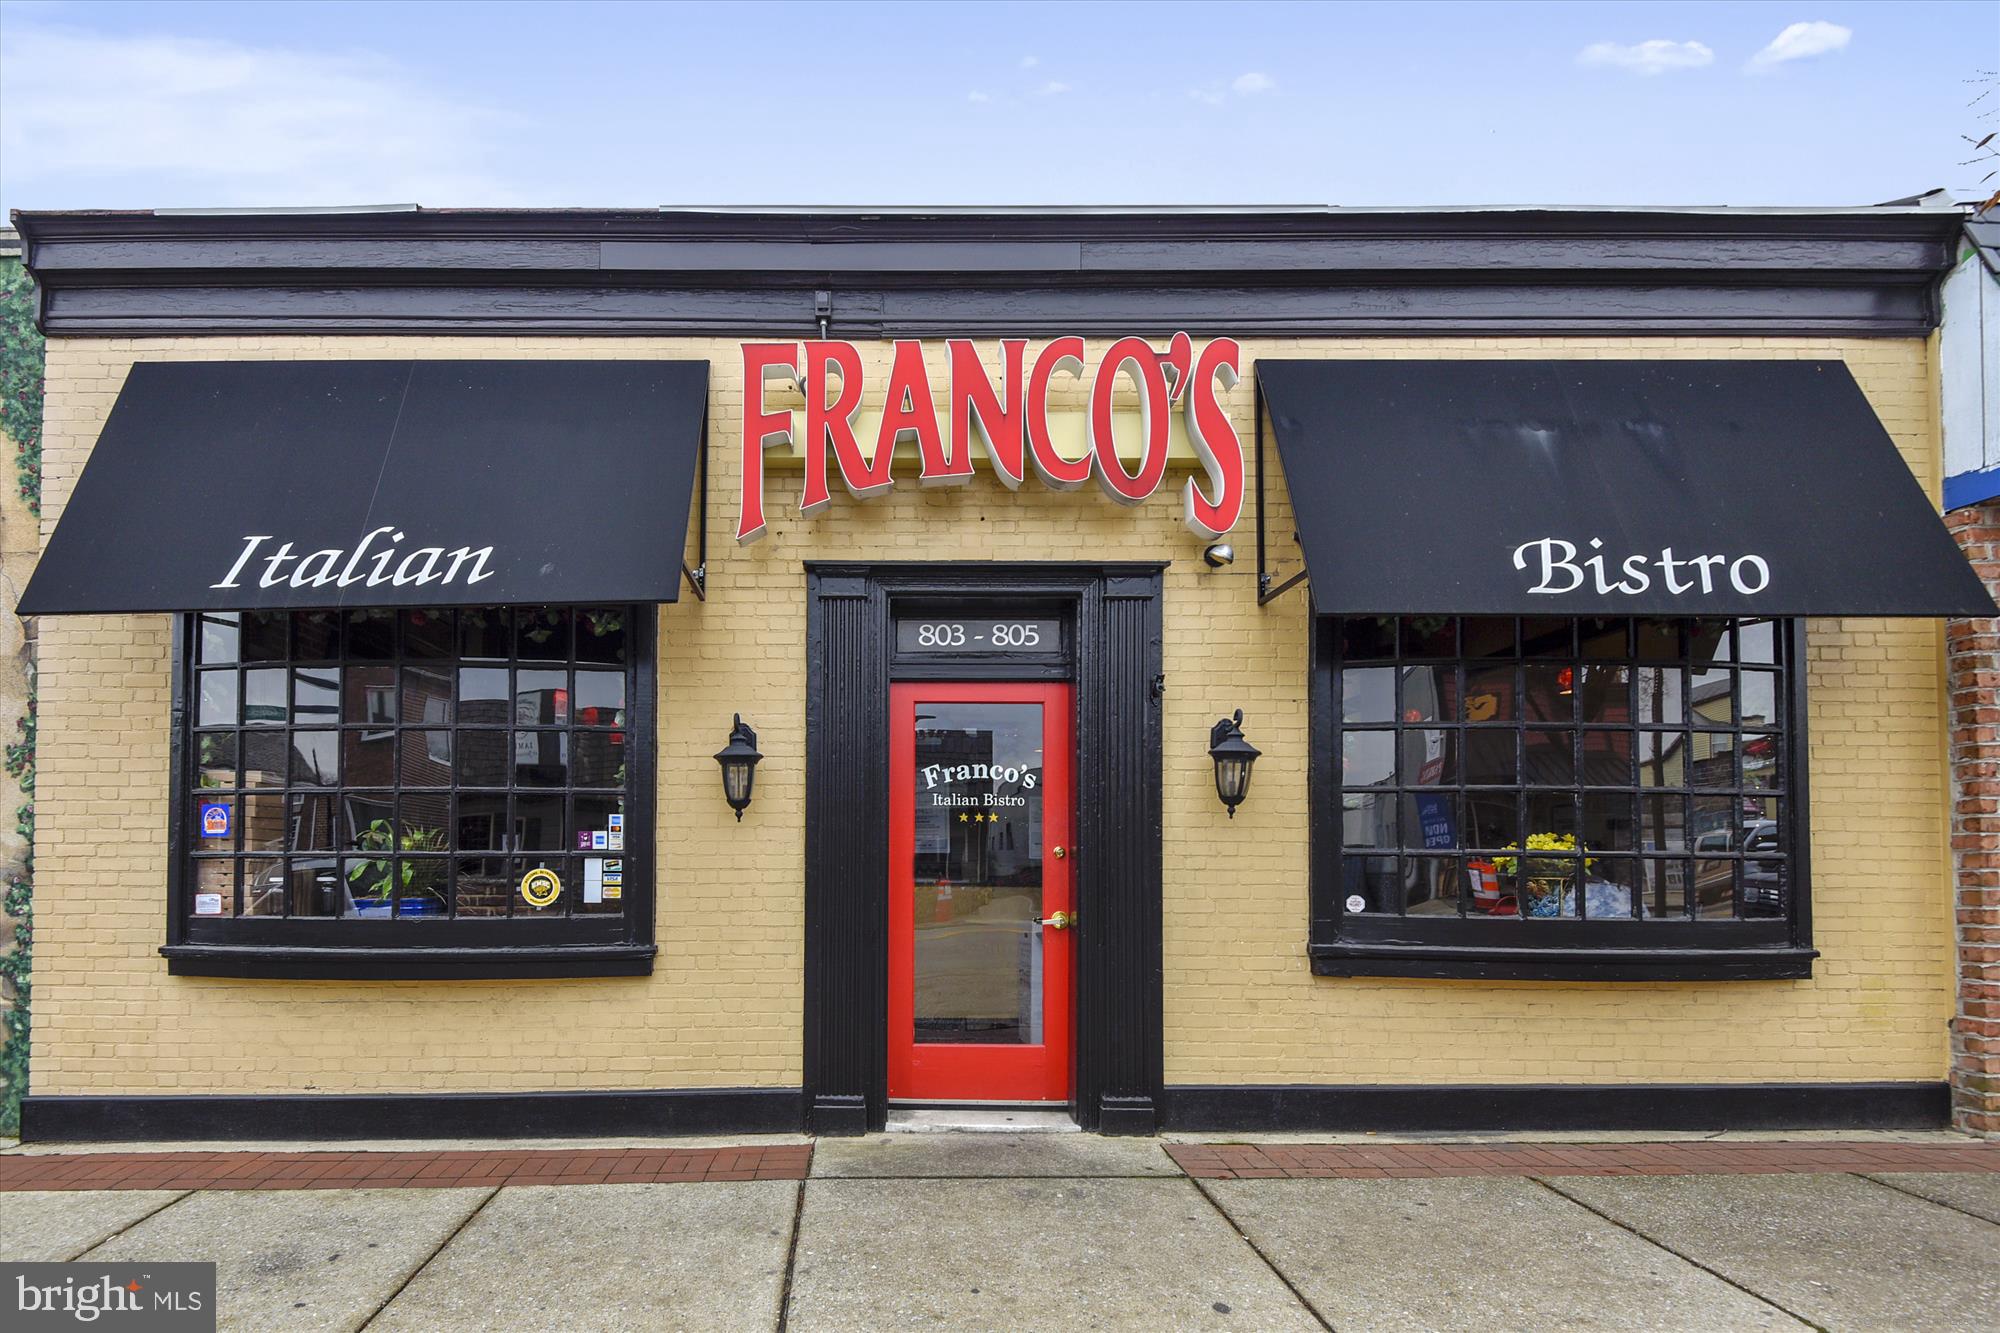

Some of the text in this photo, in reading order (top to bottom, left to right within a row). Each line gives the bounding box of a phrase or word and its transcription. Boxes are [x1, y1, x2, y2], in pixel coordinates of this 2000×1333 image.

[735, 331, 1245, 547] FRANCO'S
[209, 526, 495, 588] Italian
[1513, 537, 1770, 595] Bistro
[918, 624, 965, 646] 803
[991, 624, 1040, 646] 805
[921, 762, 1037, 789] Franco's
[932, 794, 1025, 806] Italian Bistro
